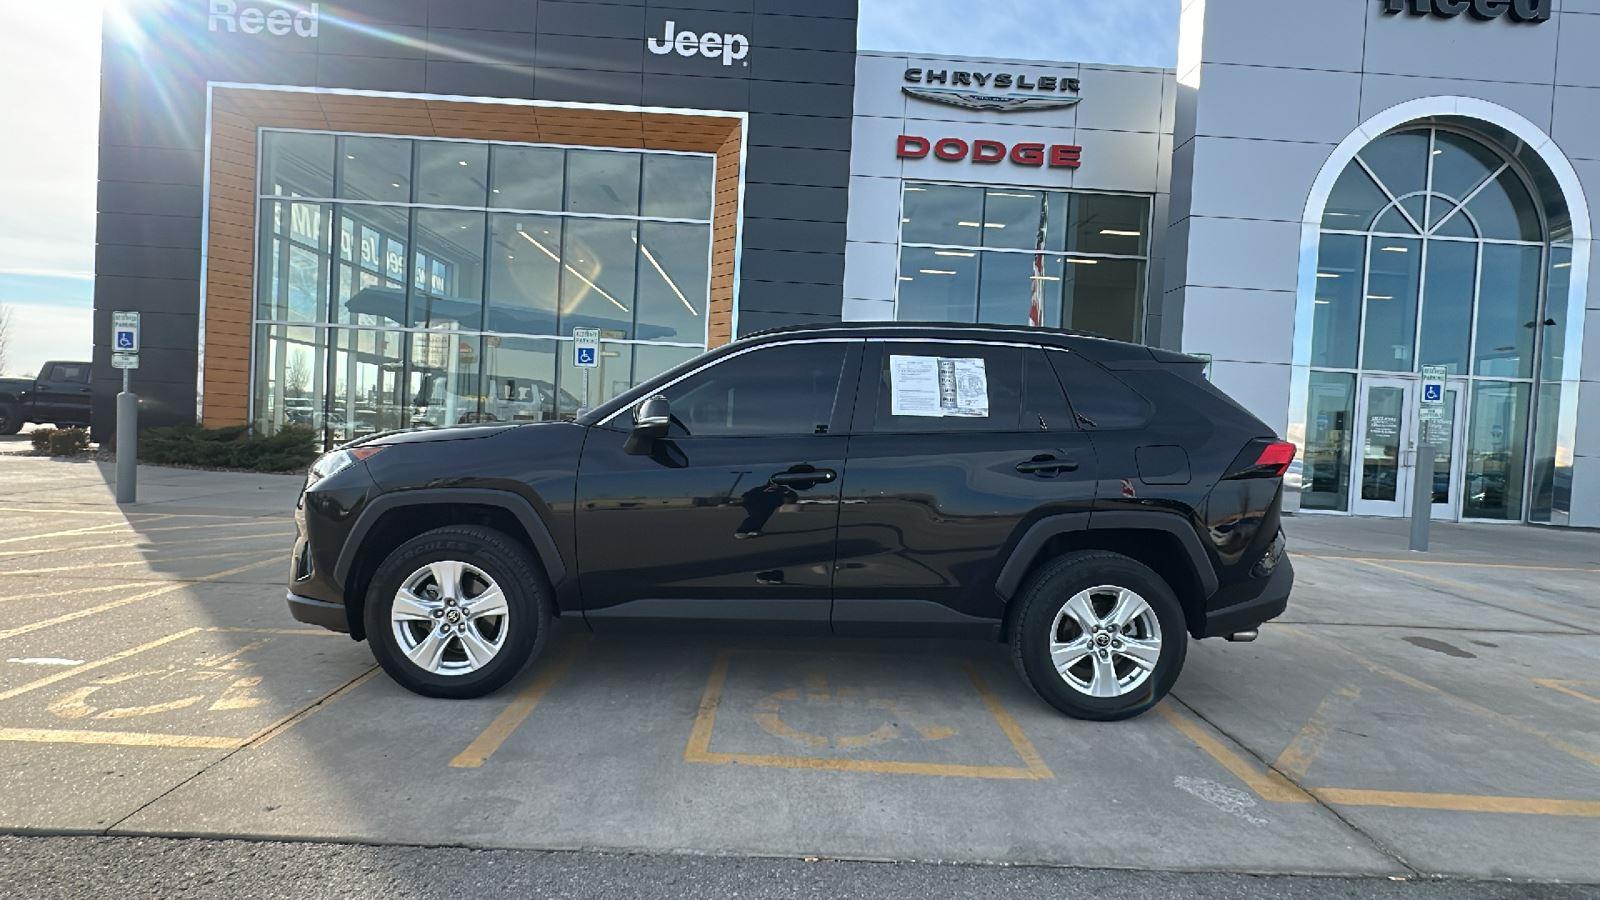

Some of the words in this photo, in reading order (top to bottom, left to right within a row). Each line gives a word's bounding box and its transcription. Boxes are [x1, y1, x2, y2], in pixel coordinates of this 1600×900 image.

[208, 0, 319, 38] Reed
[648, 20, 749, 66] Jeep
[904, 67, 1081, 91] CHRYSLER
[896, 135, 1082, 168] DODGE
